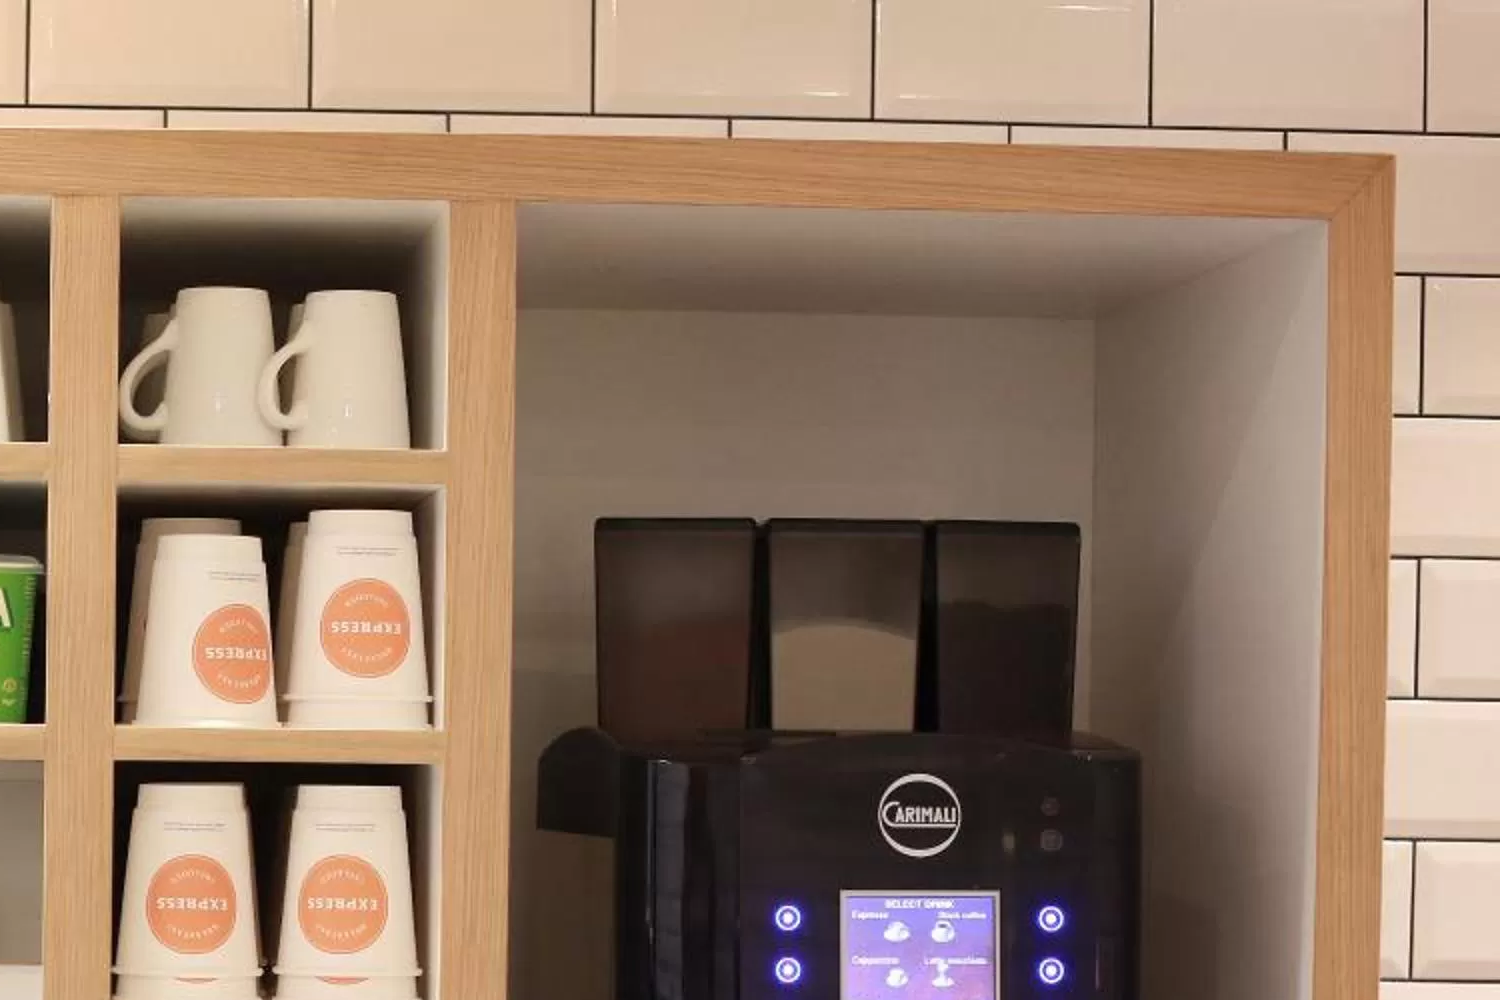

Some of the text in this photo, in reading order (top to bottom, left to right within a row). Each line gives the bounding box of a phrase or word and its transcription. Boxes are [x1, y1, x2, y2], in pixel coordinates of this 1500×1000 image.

[331, 620, 401, 636] EXPRESS
[205, 646, 269, 662] EXPRESS
[882, 801, 957, 828] CARIMALI
[156, 896, 229, 912] EXPRESS
[306, 896, 378, 911] EXPRESS
